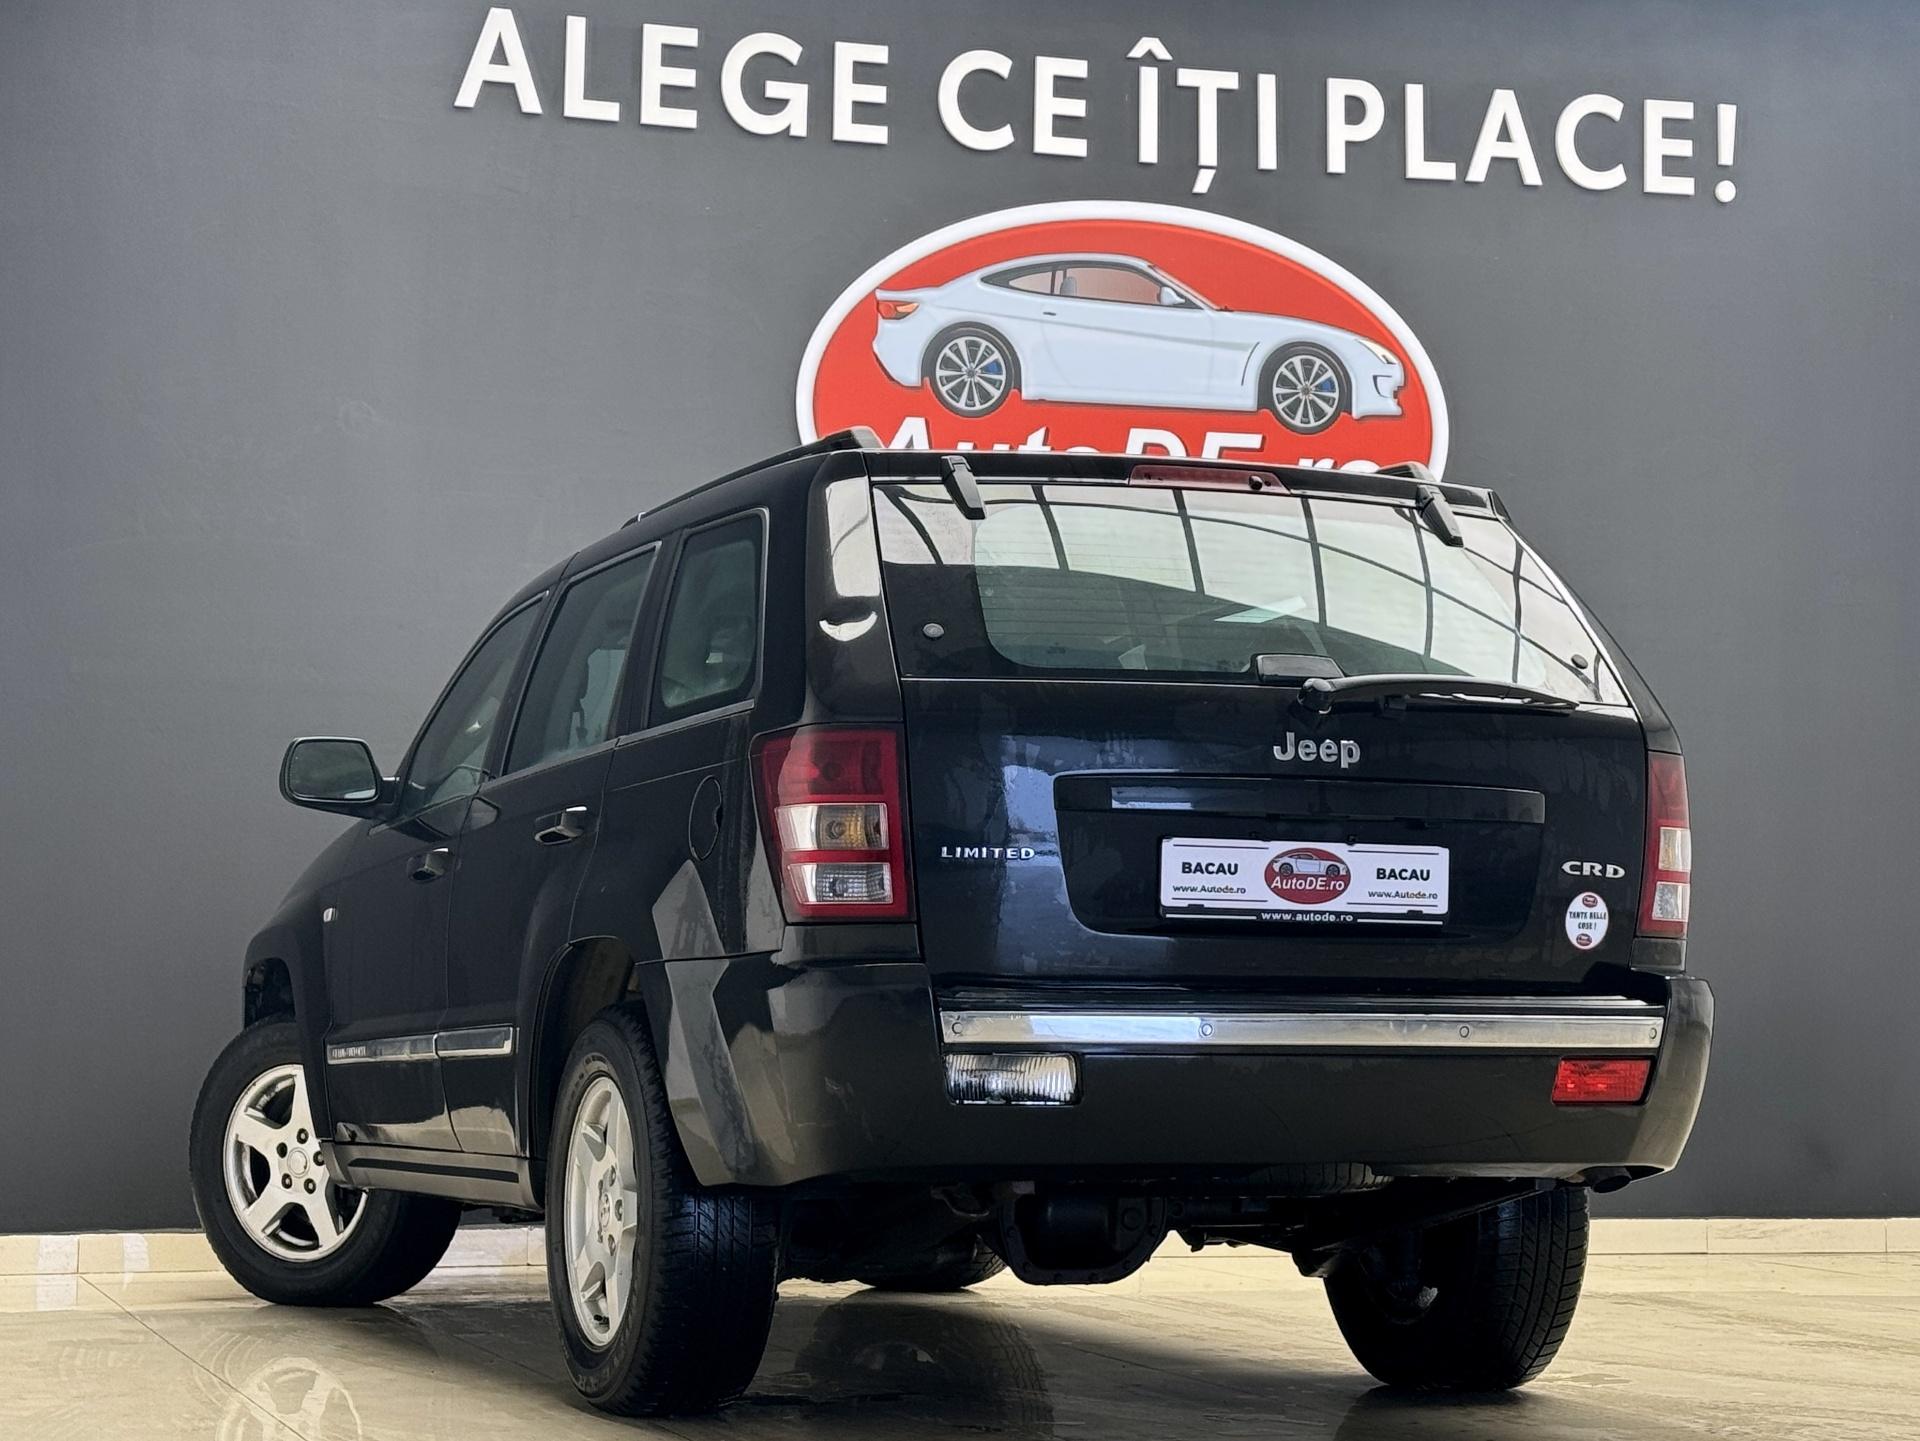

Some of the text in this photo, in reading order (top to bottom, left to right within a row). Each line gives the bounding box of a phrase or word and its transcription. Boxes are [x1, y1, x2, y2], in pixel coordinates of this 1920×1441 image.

[454, 7, 889, 145] ALEGE
[937, 49, 1089, 158] CE
[1325, 77, 1738, 203] PLACE!
[1273, 731, 1360, 769] Jeep
[941, 846, 1035, 860] LIMITED
[1181, 861, 1239, 876] BACAU
[1376, 867, 1431, 882] BACAU
[1561, 861, 1626, 879] CRD
[1172, 884, 1247, 895] www.Autode.ro
[1271, 876, 1345, 891] AutoDE.ro
[1367, 890, 1439, 900] www.Autode.ro
[1261, 912, 1354, 922] www.autode.ro
